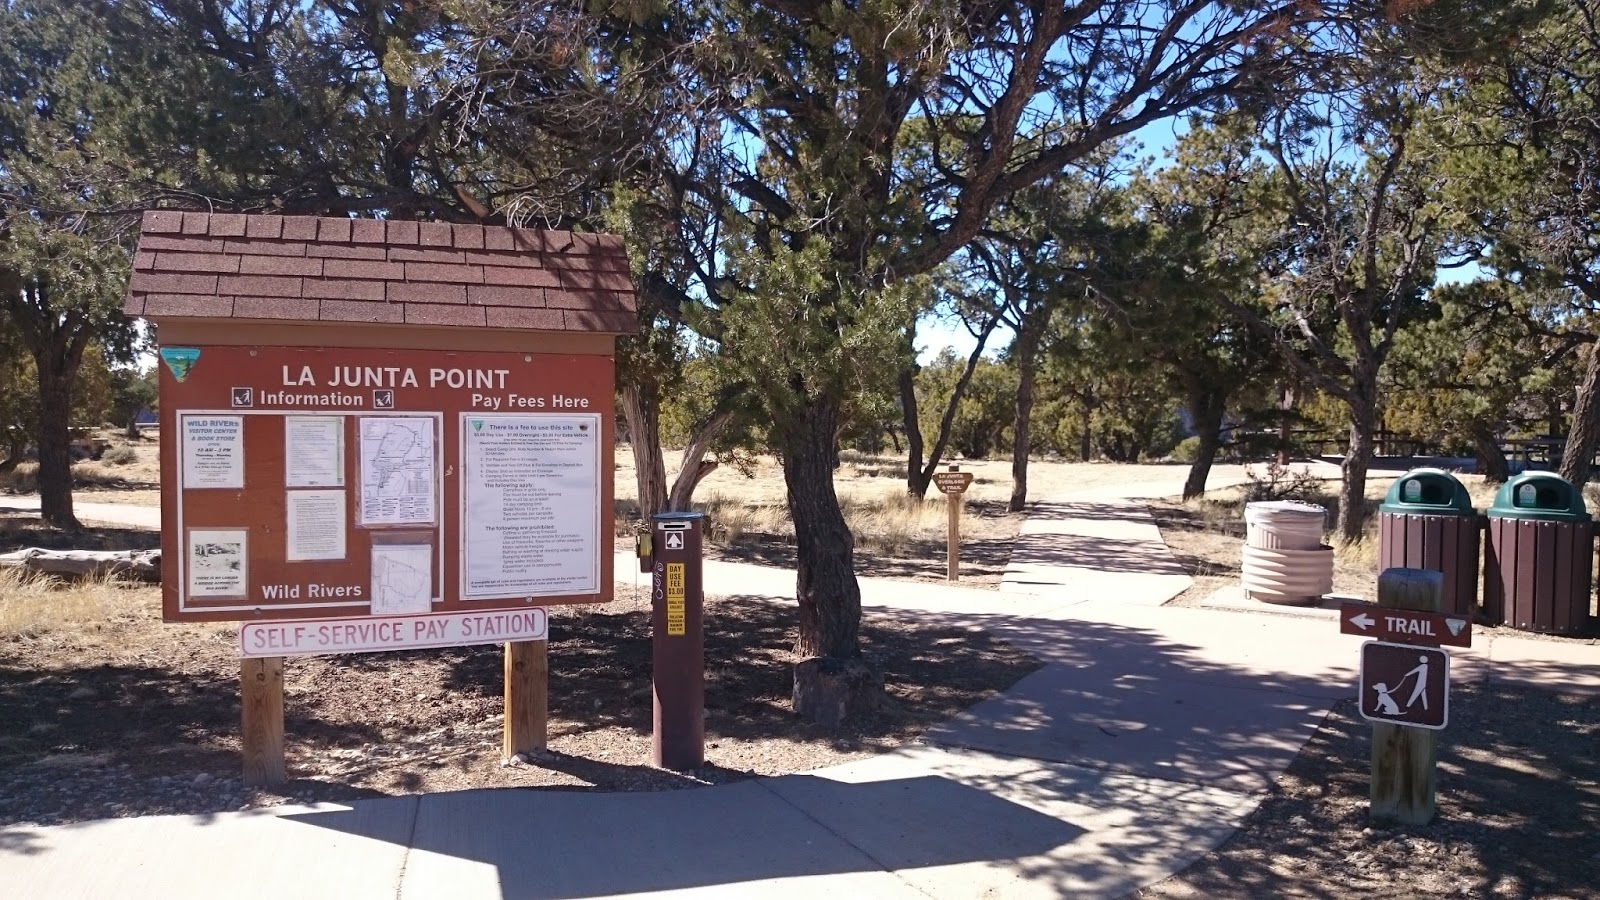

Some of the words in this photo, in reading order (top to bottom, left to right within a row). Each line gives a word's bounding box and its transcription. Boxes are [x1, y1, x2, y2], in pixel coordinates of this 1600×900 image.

[282, 365, 316, 386] LA
[328, 366, 419, 388] JUNTA
[430, 368, 510, 389] POINT
[261, 390, 363, 406] Information
[472, 394, 501, 410] Pay
[508, 394, 545, 407] Fees
[552, 395, 589, 408] Here
[262, 584, 300, 599] Wild
[307, 584, 362, 598] Rivers
[254, 622, 403, 649] SELF-SERVICE
[414, 619, 450, 640] PAY
[461, 613, 536, 637] STATION
[1384, 617, 1436, 636] TRAIL
